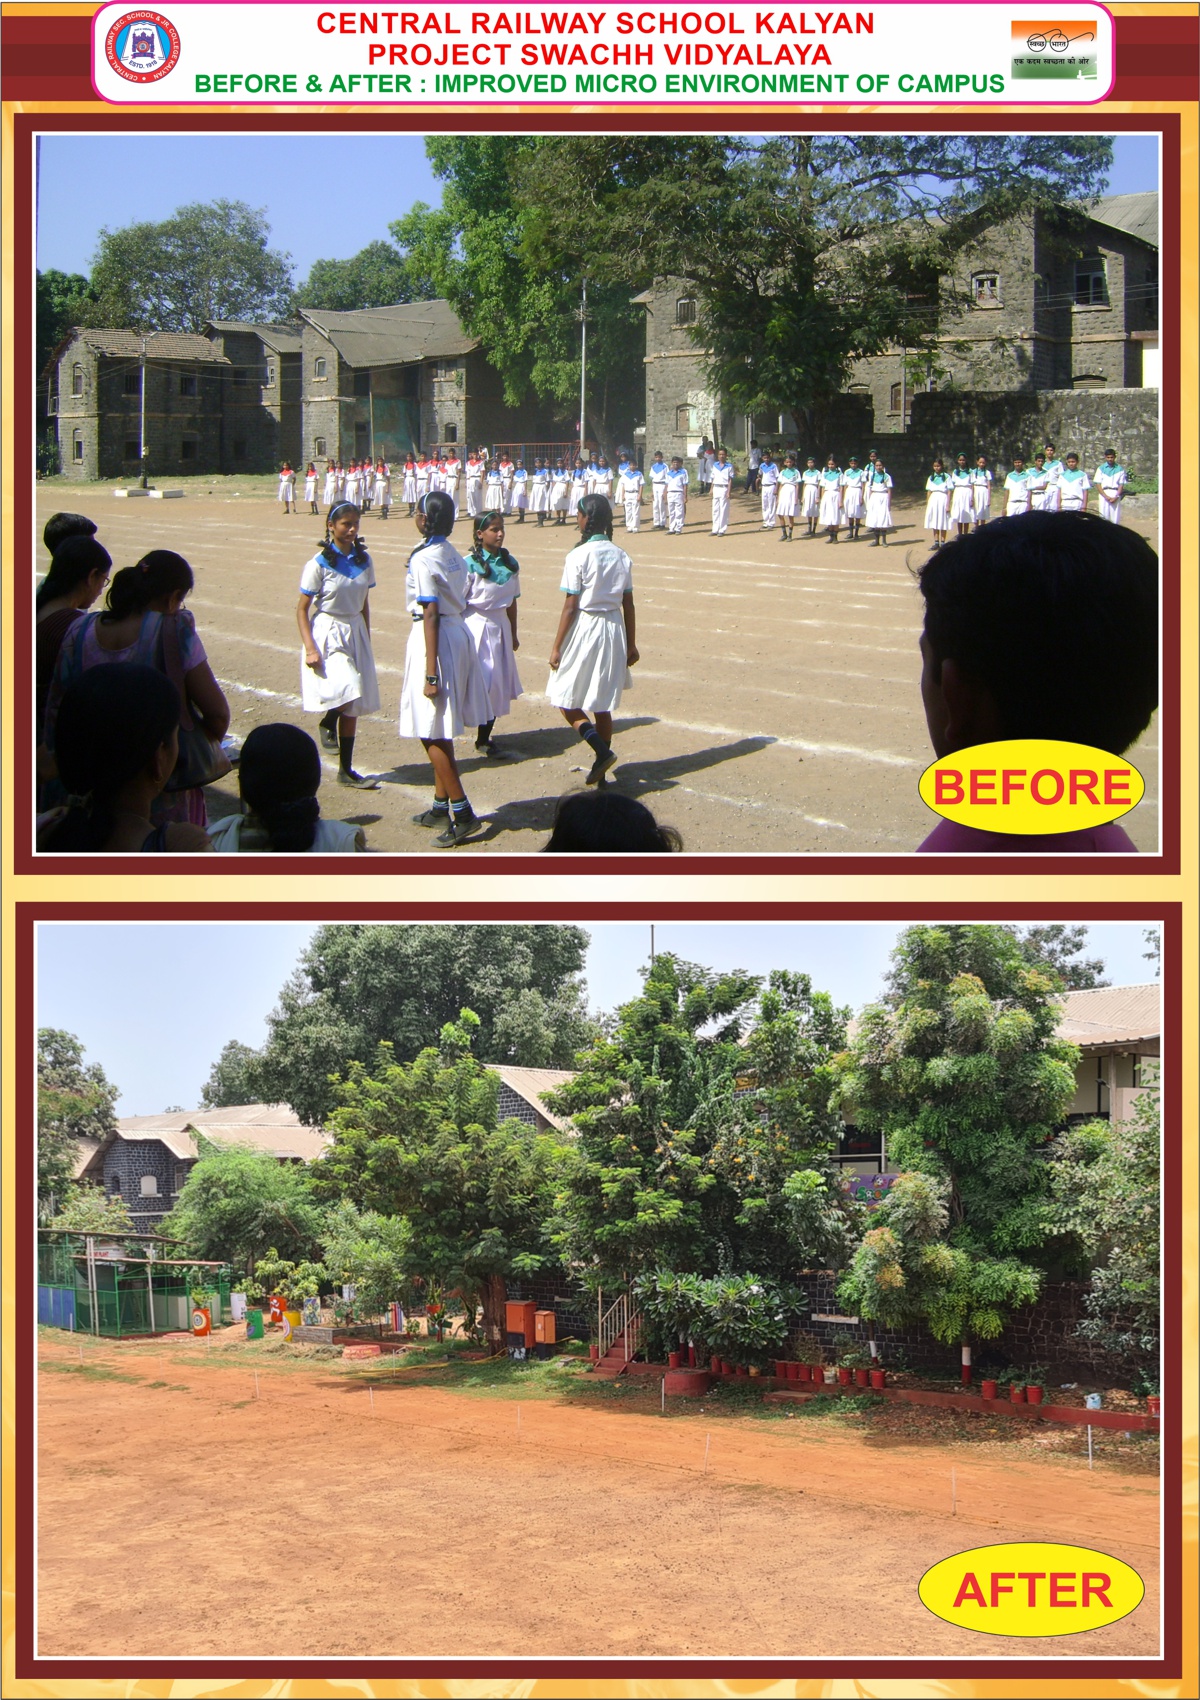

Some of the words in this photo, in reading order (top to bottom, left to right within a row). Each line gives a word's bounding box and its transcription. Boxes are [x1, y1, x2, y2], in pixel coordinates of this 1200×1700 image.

[112, 18, 127, 31] SEC.
[126, 11, 154, 21] SCHOOL
[160, 18, 169, 29] JR.
[316, 11, 461, 35] CENTRAL
[471, 12, 607, 34] RAILWAY
[616, 11, 745, 35] SCHOOL
[755, 12, 874, 34] KALYAN
[107, 31, 115, 60] RAILWAY
[168, 28, 179, 59] COLLEGE
[128, 59, 145, 69] ESTD.
[368, 43, 512, 66] PROJECT
[520, 43, 653, 66] SWACHH
[663, 43, 832, 66] VIDYALAYA
[1014, 58, 1024, 66] एक
[1067, 56, 1076, 65] की
[1078, 56, 1090, 65] ओर
[111, 60, 138, 81] CENTRAL
[153, 59, 175, 80] KALYAN
[195, 73, 298, 94] BEFORE
[305, 74, 323, 93] &
[328, 74, 412, 93] AFTER
[420, 79, 426, 93] :
[435, 73, 567, 94] IMPROVED
[575, 73, 657, 94] MICRO
[665, 73, 850, 94] ENVIRONMENT
[856, 73, 890, 94] OF
[897, 73, 1005, 94] CAMPUS
